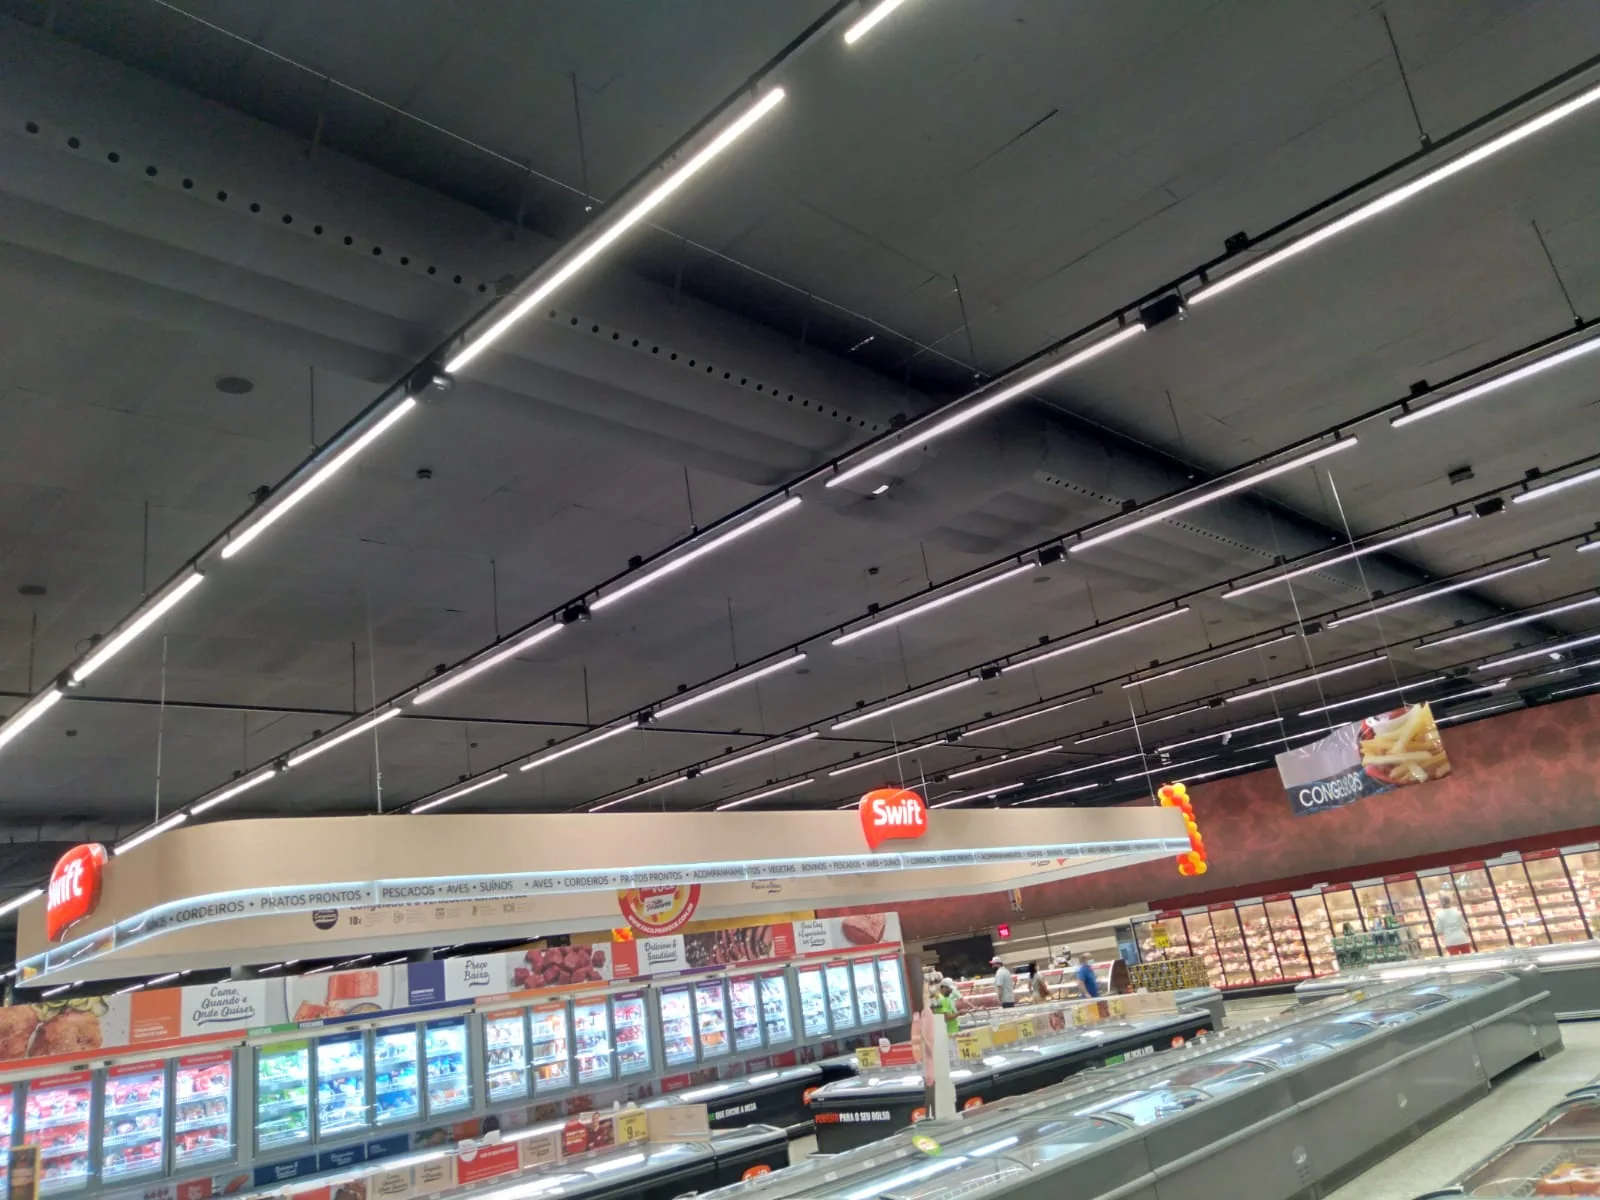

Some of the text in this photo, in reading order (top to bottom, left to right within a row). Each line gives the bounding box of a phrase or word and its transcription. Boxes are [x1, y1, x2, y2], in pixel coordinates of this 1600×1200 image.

[1299, 772, 1364, 807] CONGEOS
[872, 798, 924, 826] Swift
[176, 901, 245, 924] CORDEIROS
[260, 894, 306, 909] PRATOS
[309, 890, 362, 904] PRONTOS
[382, 885, 435, 898] PESCADOS
[446, 883, 470, 894] AVES
[479, 879, 513, 892] SUÍNOS
[532, 878, 553, 889] AVES
[564, 876, 609, 887] CORDEIROS
[619, 873, 648, 884] PRATOS
[649, 871, 683, 882] PRONTOS
[465, 959, 488, 971] Preço
[464, 970, 490, 981] Baixo
[201, 997, 241, 1009] Quando
[192, 1004, 255, 1022] Onde Quiser
[839, 1112, 855, 1123] PARA
[859, 1111, 871, 1122] SEU
[871, 1110, 891, 1121] BOLSO
